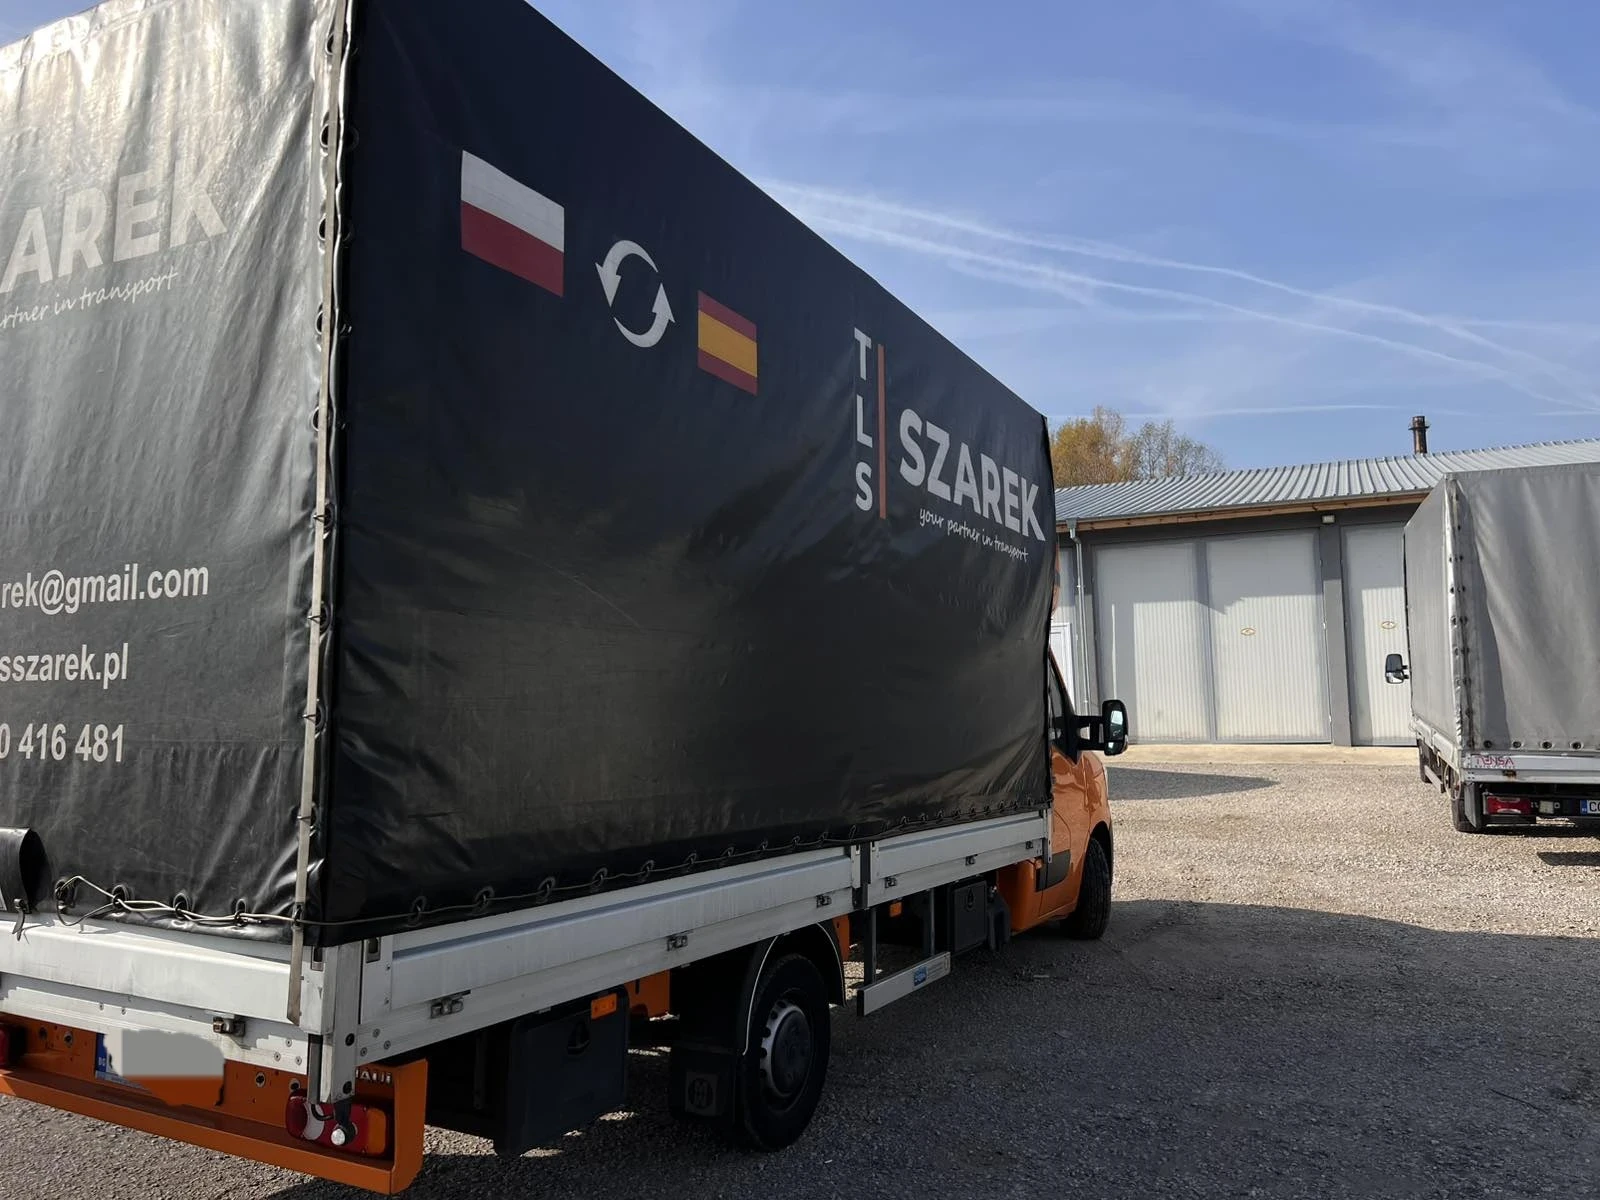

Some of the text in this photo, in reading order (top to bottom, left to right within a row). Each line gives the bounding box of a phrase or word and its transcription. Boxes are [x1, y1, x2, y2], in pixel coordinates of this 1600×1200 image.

[54, 293, 77, 315] in
[79, 265, 179, 310] transport
[899, 408, 1046, 542] SZAREK
[919, 507, 1029, 563] your partner in transport
[1, 563, 209, 615] rek@gmail.com
[0, 642, 129, 690] sszarek.pl
[18, 722, 67, 761] 416
[75, 723, 124, 763] 481
